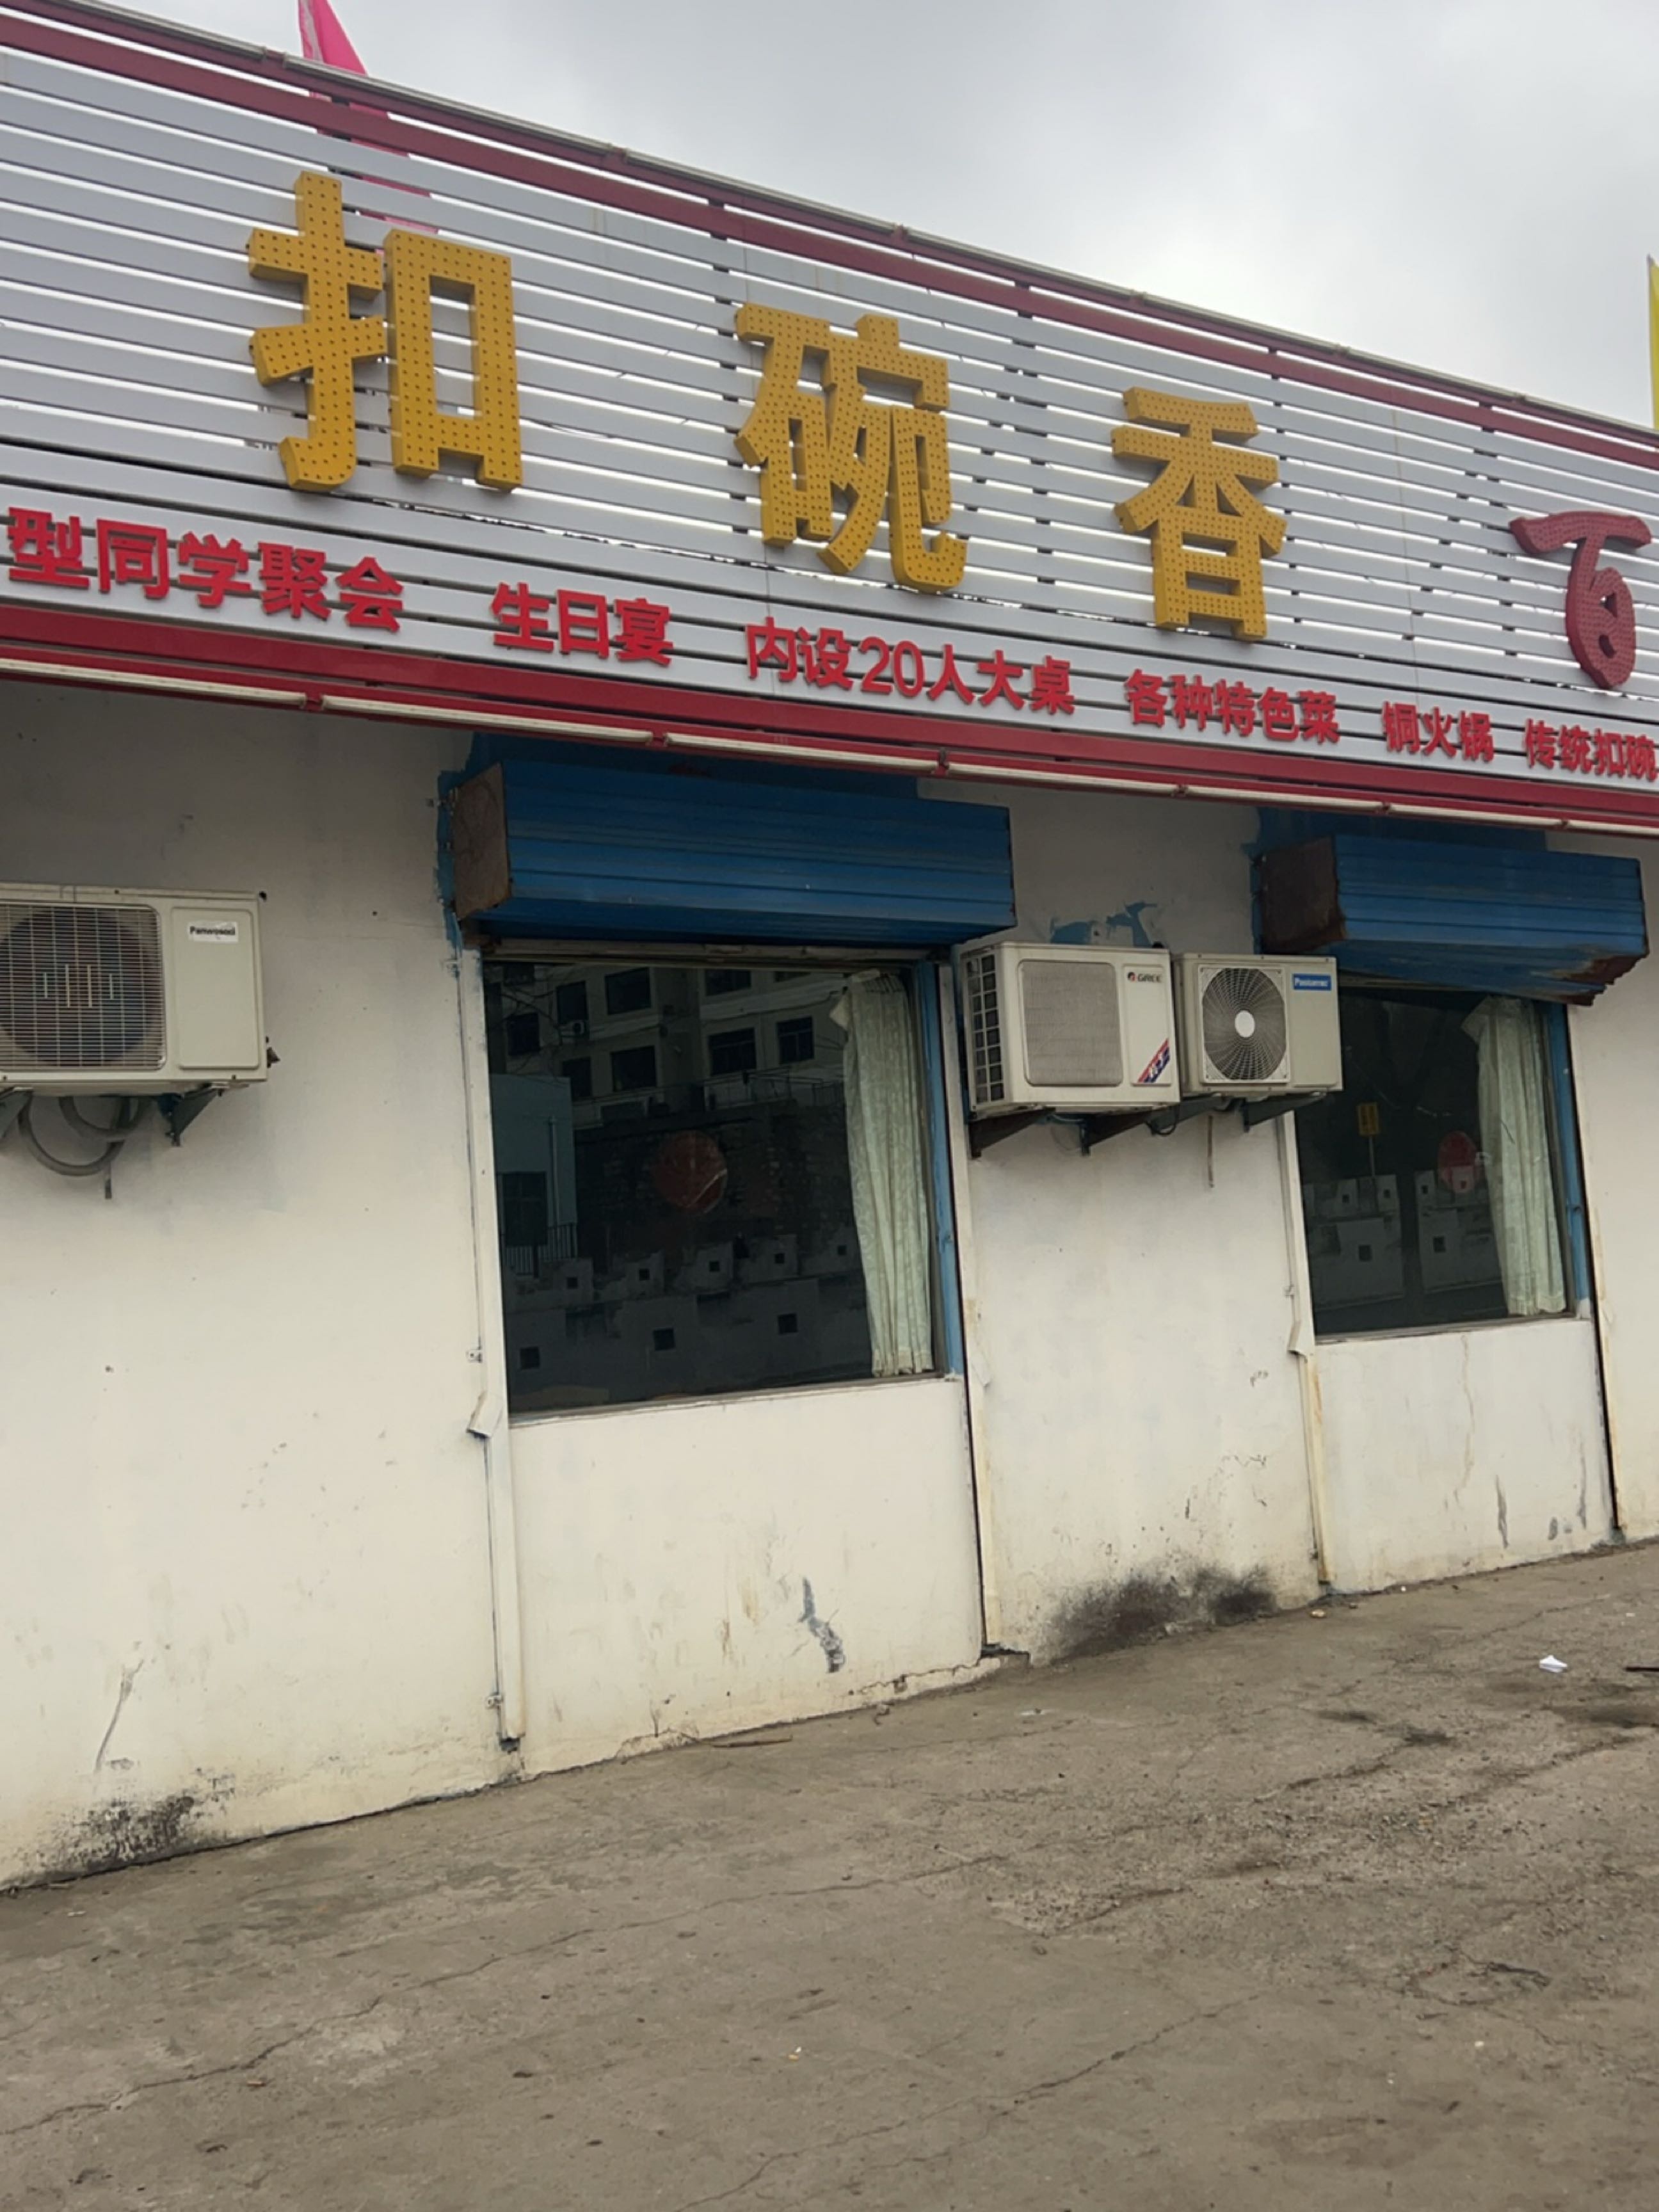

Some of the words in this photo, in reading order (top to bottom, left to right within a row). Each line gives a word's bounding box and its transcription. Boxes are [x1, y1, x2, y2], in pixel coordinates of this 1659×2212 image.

[247, 173, 1286, 639] 扣碗香
[8, 506, 405, 632] 型同学聚会
[491, 582, 673, 666] 生日宴
[745, 616, 1075, 714] 内设20人大桌
[1125, 669, 1341, 743] 各种特色菜
[1382, 701, 1496, 762] 铜火锅
[1525, 719, 1657, 781] 传统扣碗
